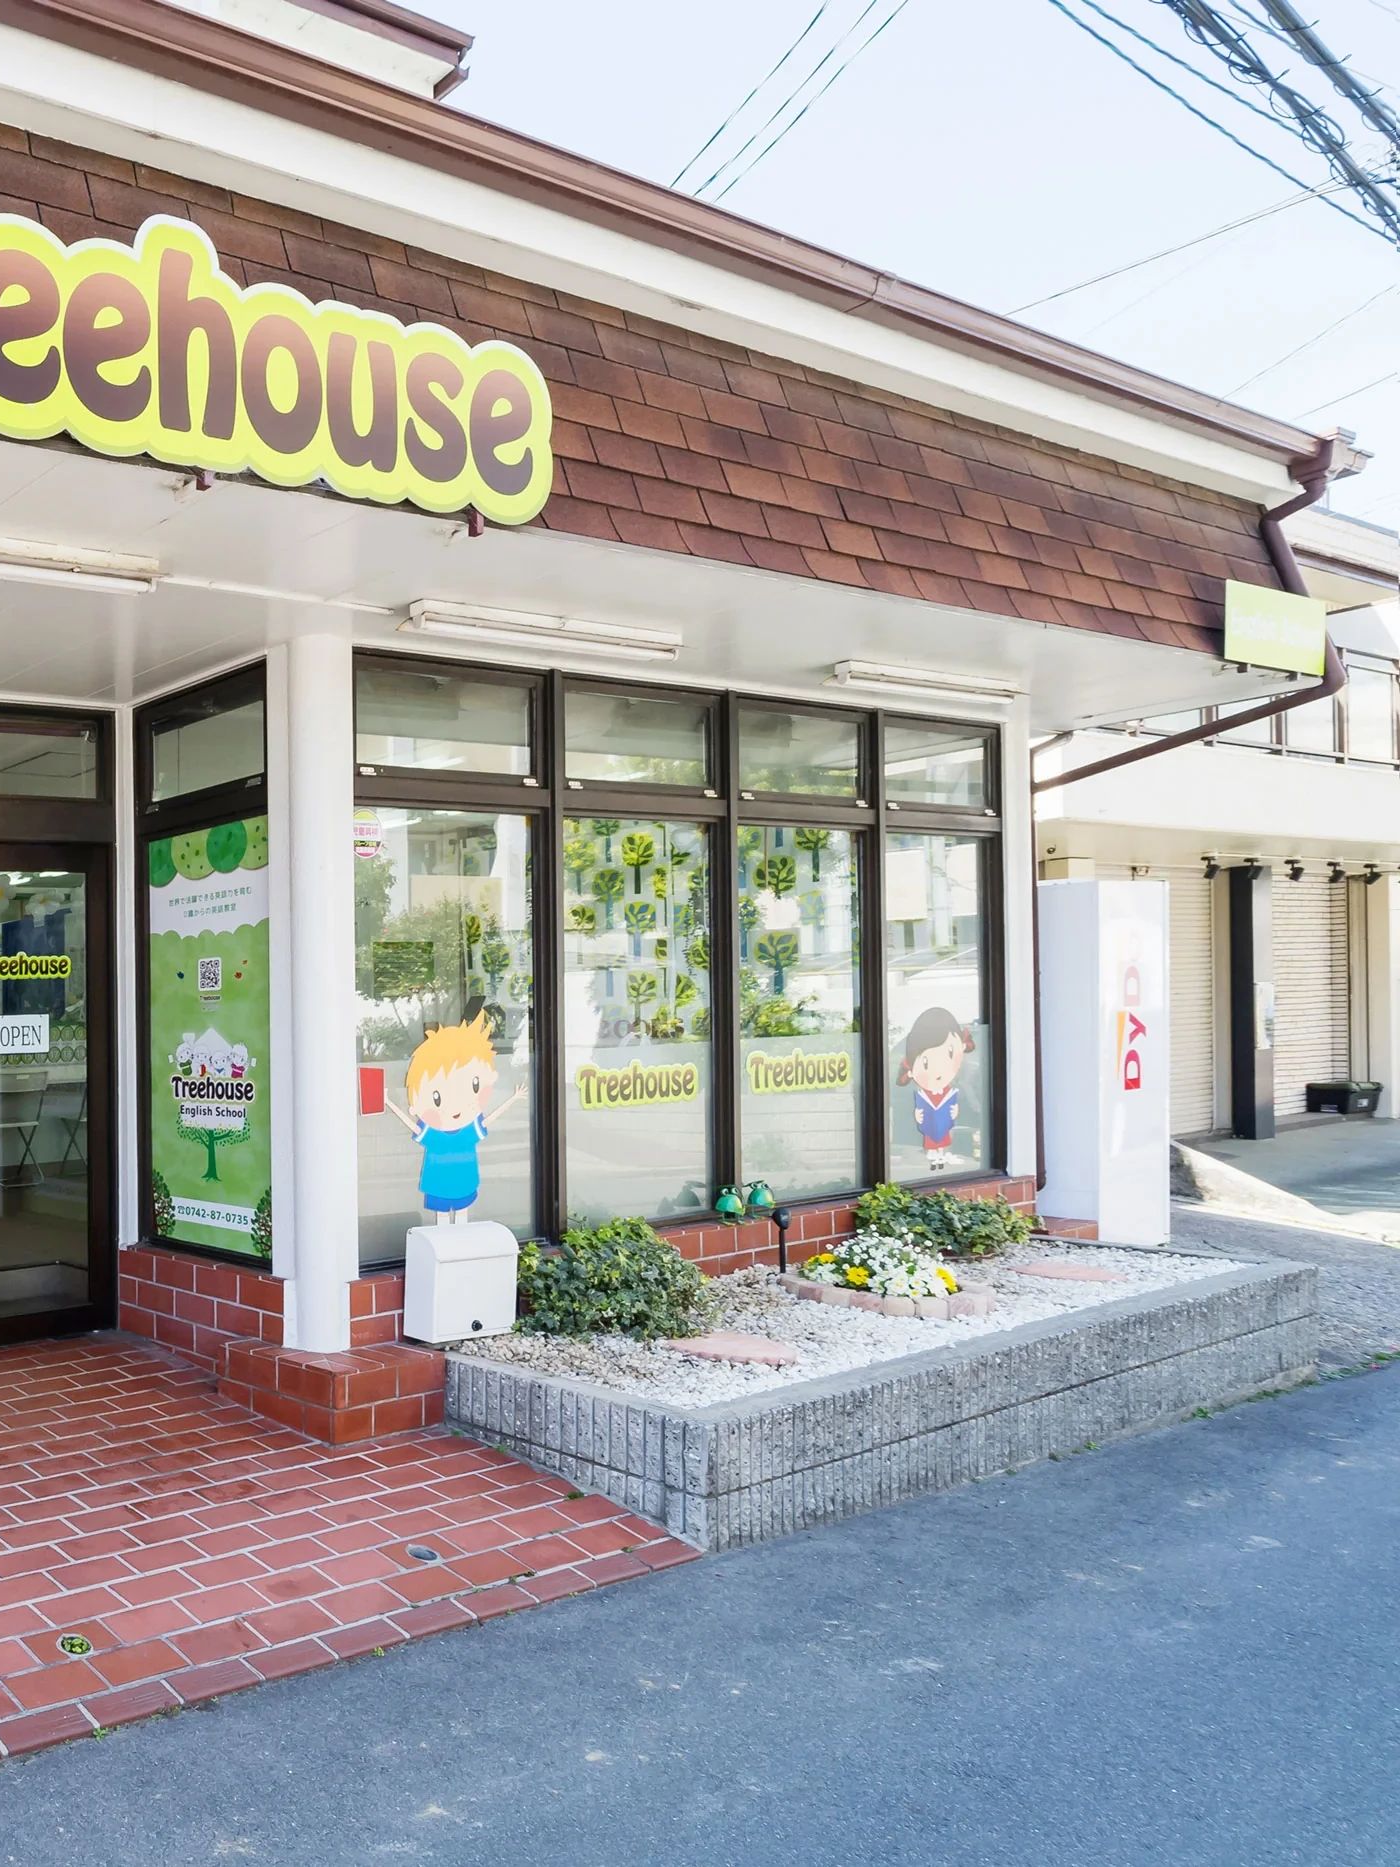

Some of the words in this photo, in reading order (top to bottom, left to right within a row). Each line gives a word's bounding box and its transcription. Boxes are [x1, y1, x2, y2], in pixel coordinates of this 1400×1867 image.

[0, 1025, 42, 1047] OPEN
[750, 1054, 848, 1090] Treehouse
[171, 1075, 254, 1102] Treehouse
[579, 1066, 695, 1105] Treehouse
[180, 1104, 213, 1119] English
[215, 1106, 246, 1119] School
[185, 1205, 249, 1225] 0742-87-0735
